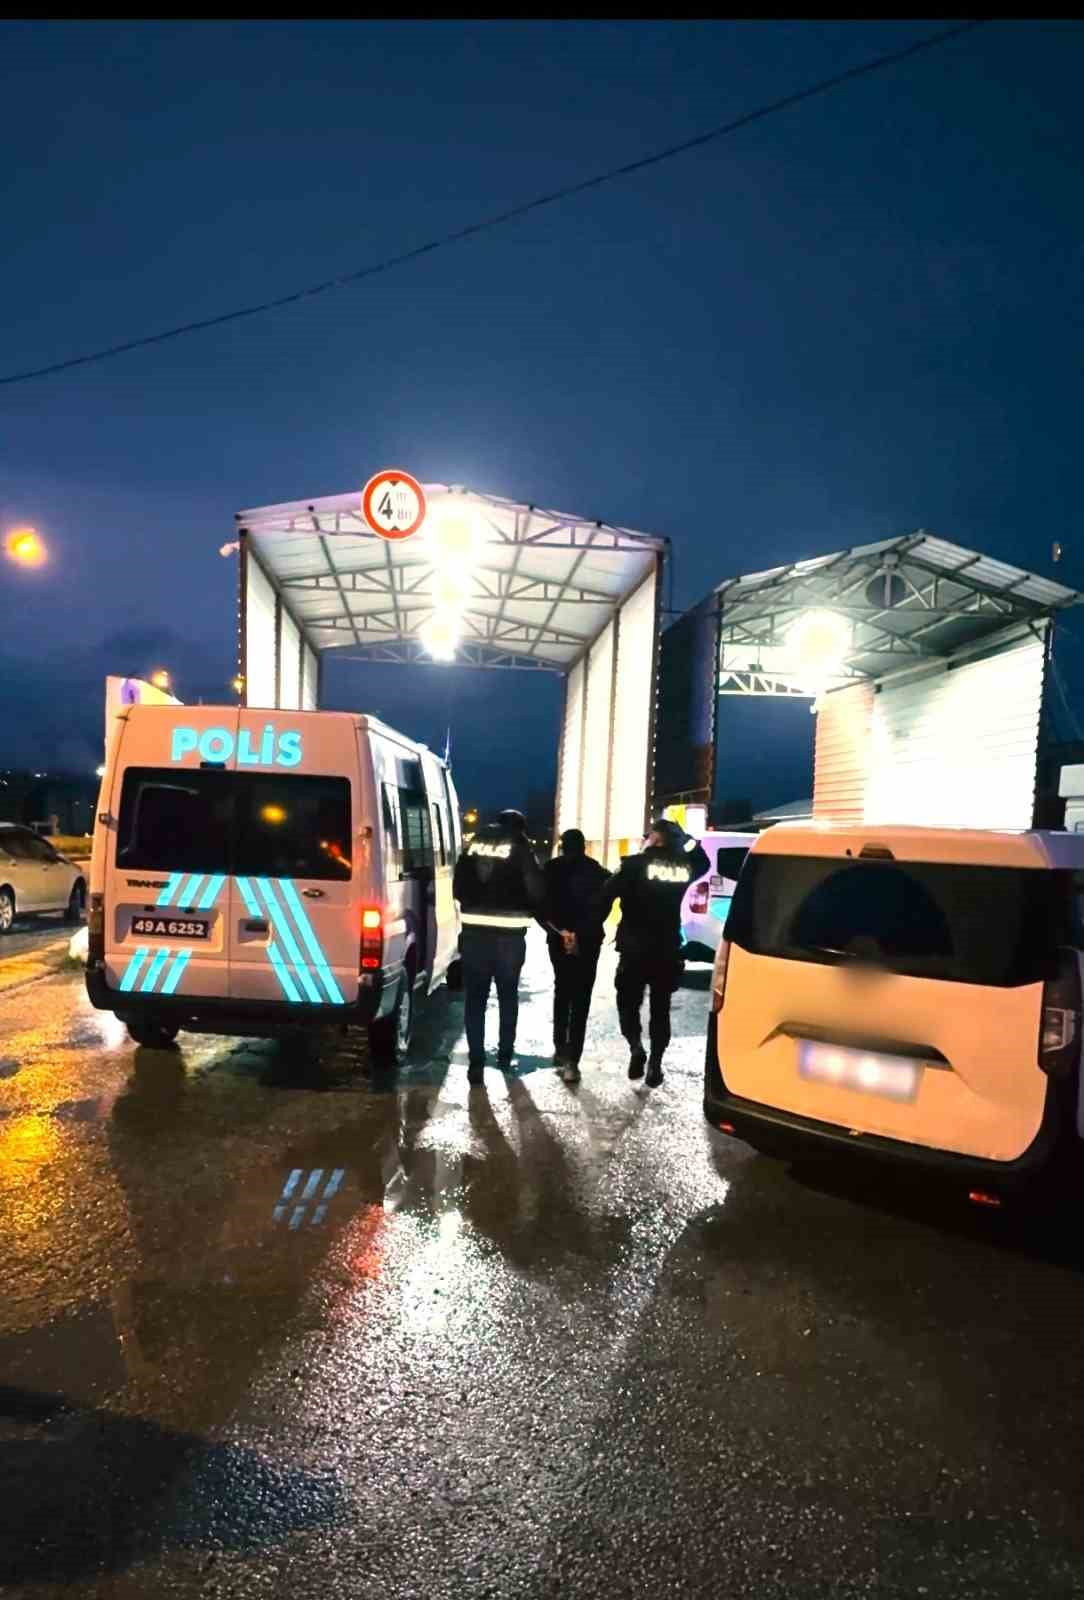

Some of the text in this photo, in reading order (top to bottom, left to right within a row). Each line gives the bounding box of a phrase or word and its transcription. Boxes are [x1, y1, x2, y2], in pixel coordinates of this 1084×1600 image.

[378, 491, 393, 520] 4
[171, 724, 303, 767] POLİS
[135, 920, 205, 936] 49 A 6252
